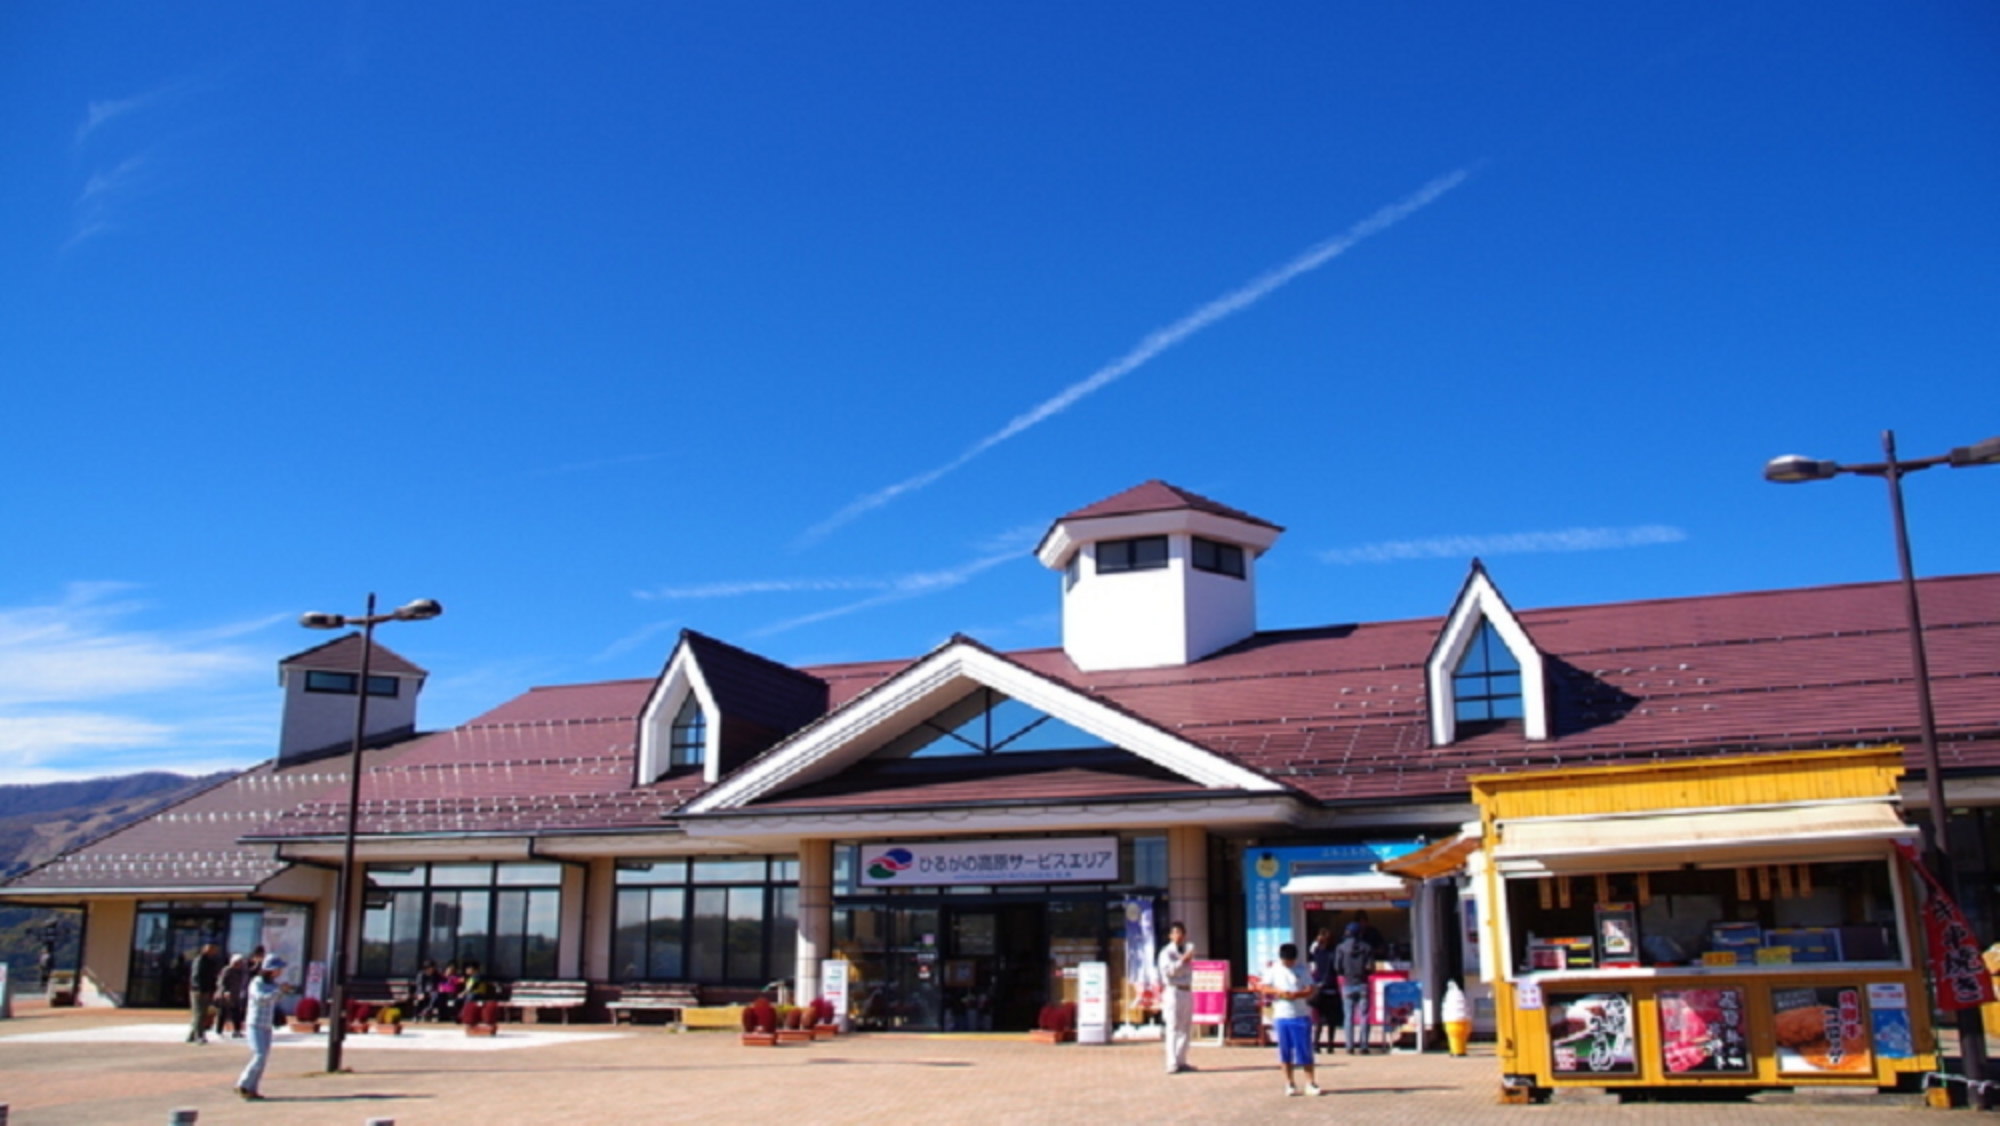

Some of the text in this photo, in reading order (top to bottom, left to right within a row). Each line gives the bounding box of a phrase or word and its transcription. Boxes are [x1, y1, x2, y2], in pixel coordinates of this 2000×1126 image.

[919, 851, 1112, 873] ひるがの高原サービスエリア
